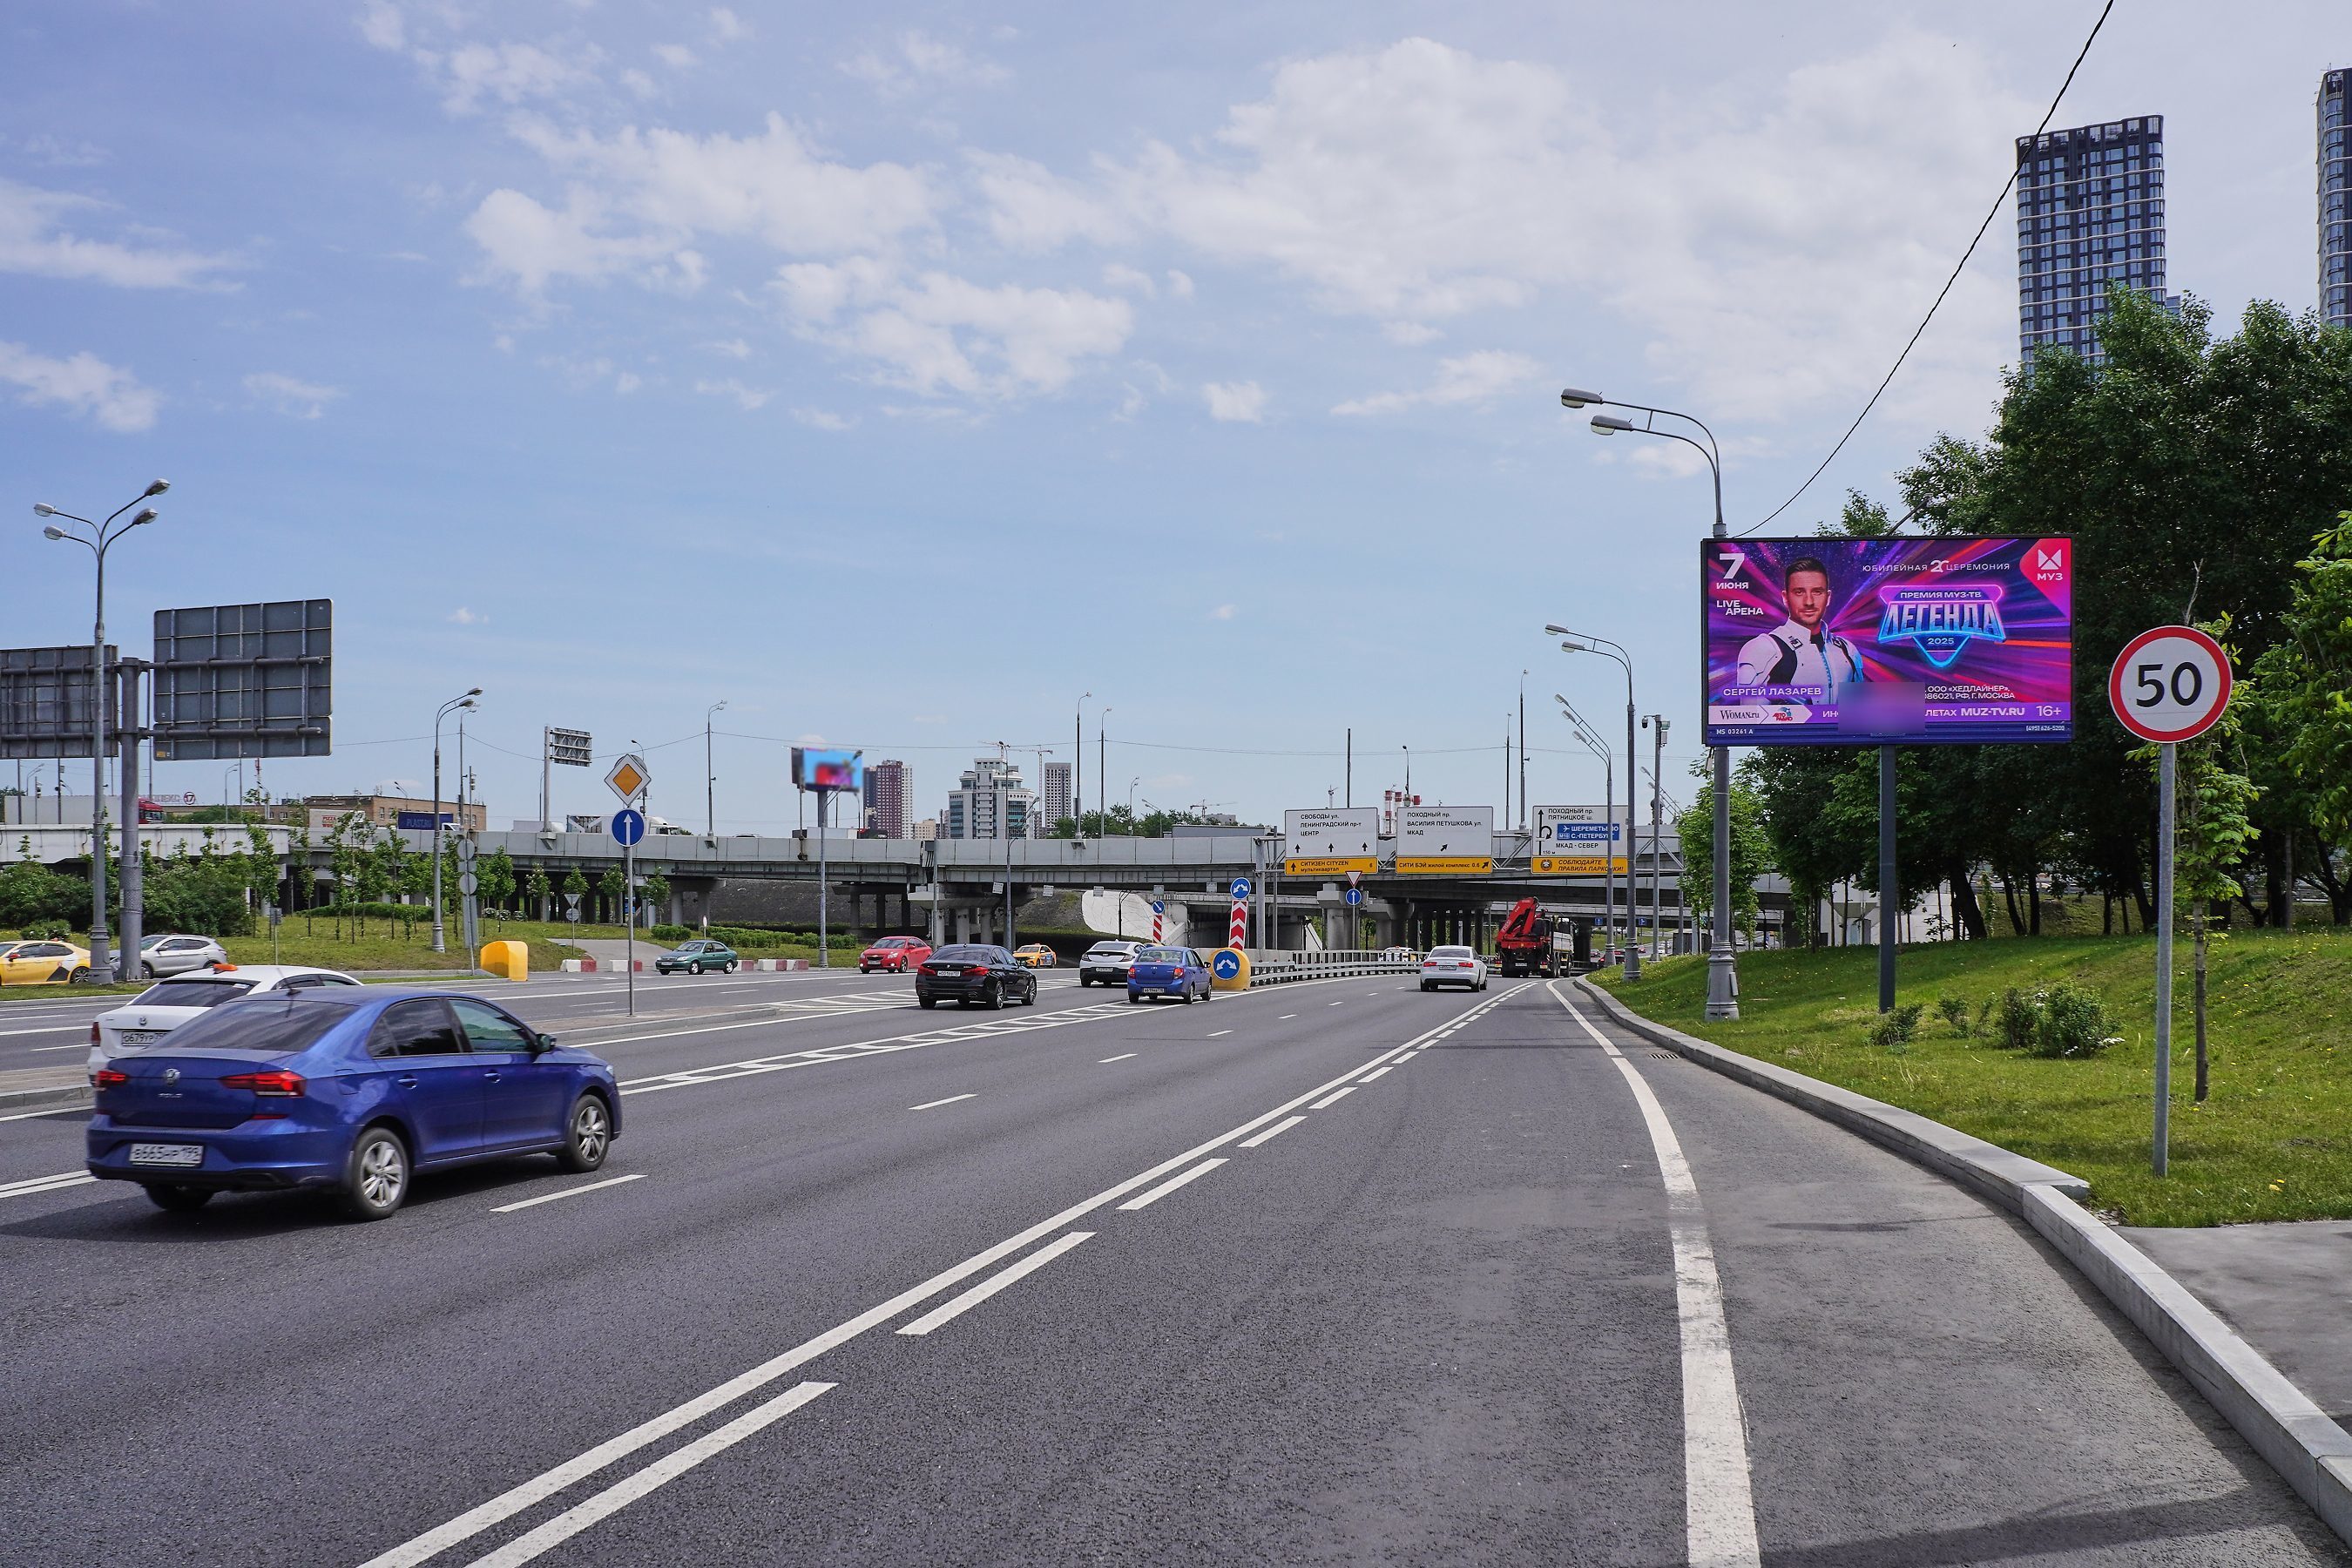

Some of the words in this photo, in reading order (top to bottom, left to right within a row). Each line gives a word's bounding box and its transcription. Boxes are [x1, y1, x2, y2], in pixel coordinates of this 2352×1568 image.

[1719, 553, 1745, 579] 7
[1862, 564, 1928, 572] ЮБИЛЕЙНАЯ
[1946, 563, 2010, 571] ЦЕРЕМОНИЯ
[1716, 599, 1740, 608] LIVE
[1726, 607, 1764, 616] АРЕНА
[1885, 603, 1999, 636] ЛЕГЕНДА
[1927, 637, 1955, 645] 2025
[2136, 661, 2202, 708] 50
[1723, 686, 1767, 696] СЕРГЕЙ
[1768, 687, 1821, 696] ЛАЗАРЕВ
[1961, 707, 2025, 716] MUZ-TV.RU
[2036, 706, 2062, 717] 16+
